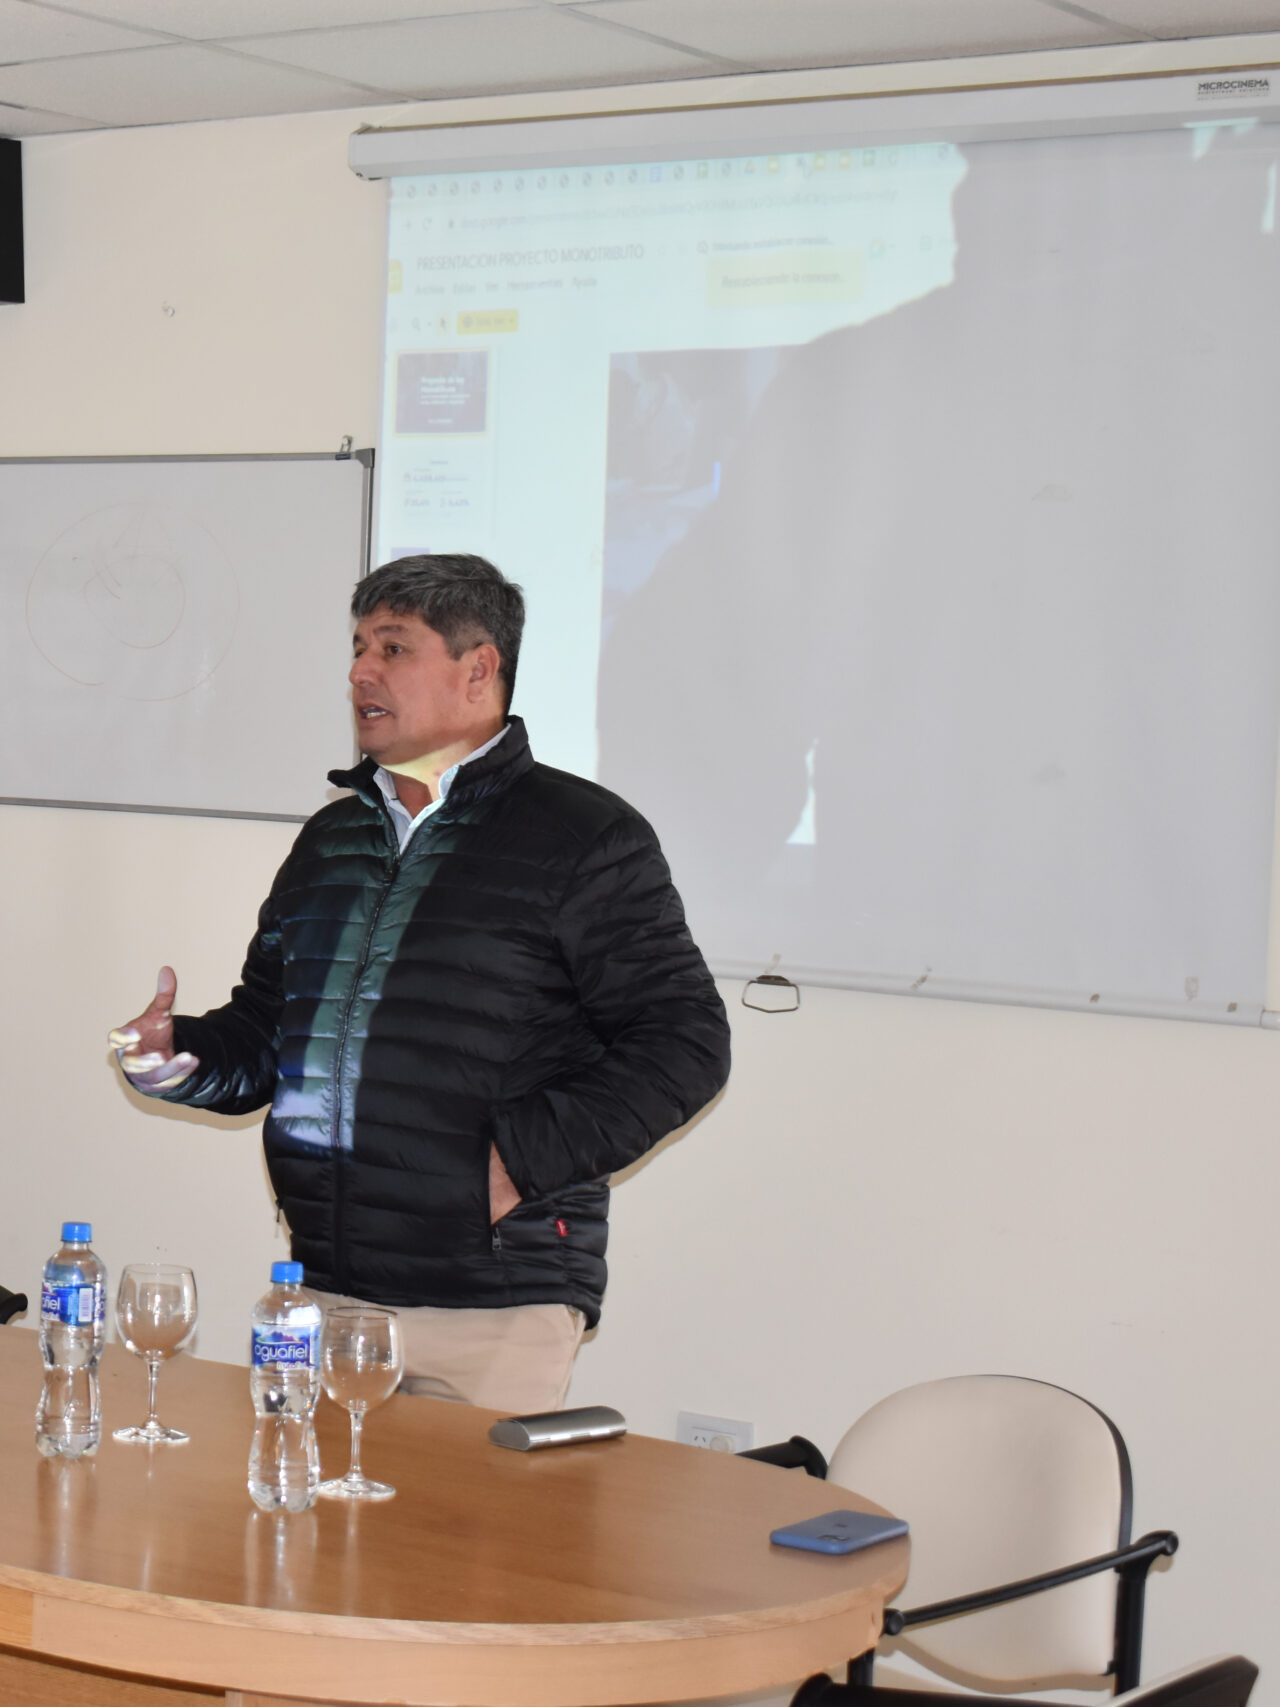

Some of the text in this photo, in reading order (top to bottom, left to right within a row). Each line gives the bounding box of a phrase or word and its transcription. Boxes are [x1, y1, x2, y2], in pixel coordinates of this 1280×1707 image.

[1198, 78, 1269, 91] MICROCINEMA
[499, 248, 558, 267] PROYECTO
[560, 243, 645, 264] MONOTRIBUTO
[254, 1343, 308, 1362] aguafiel
